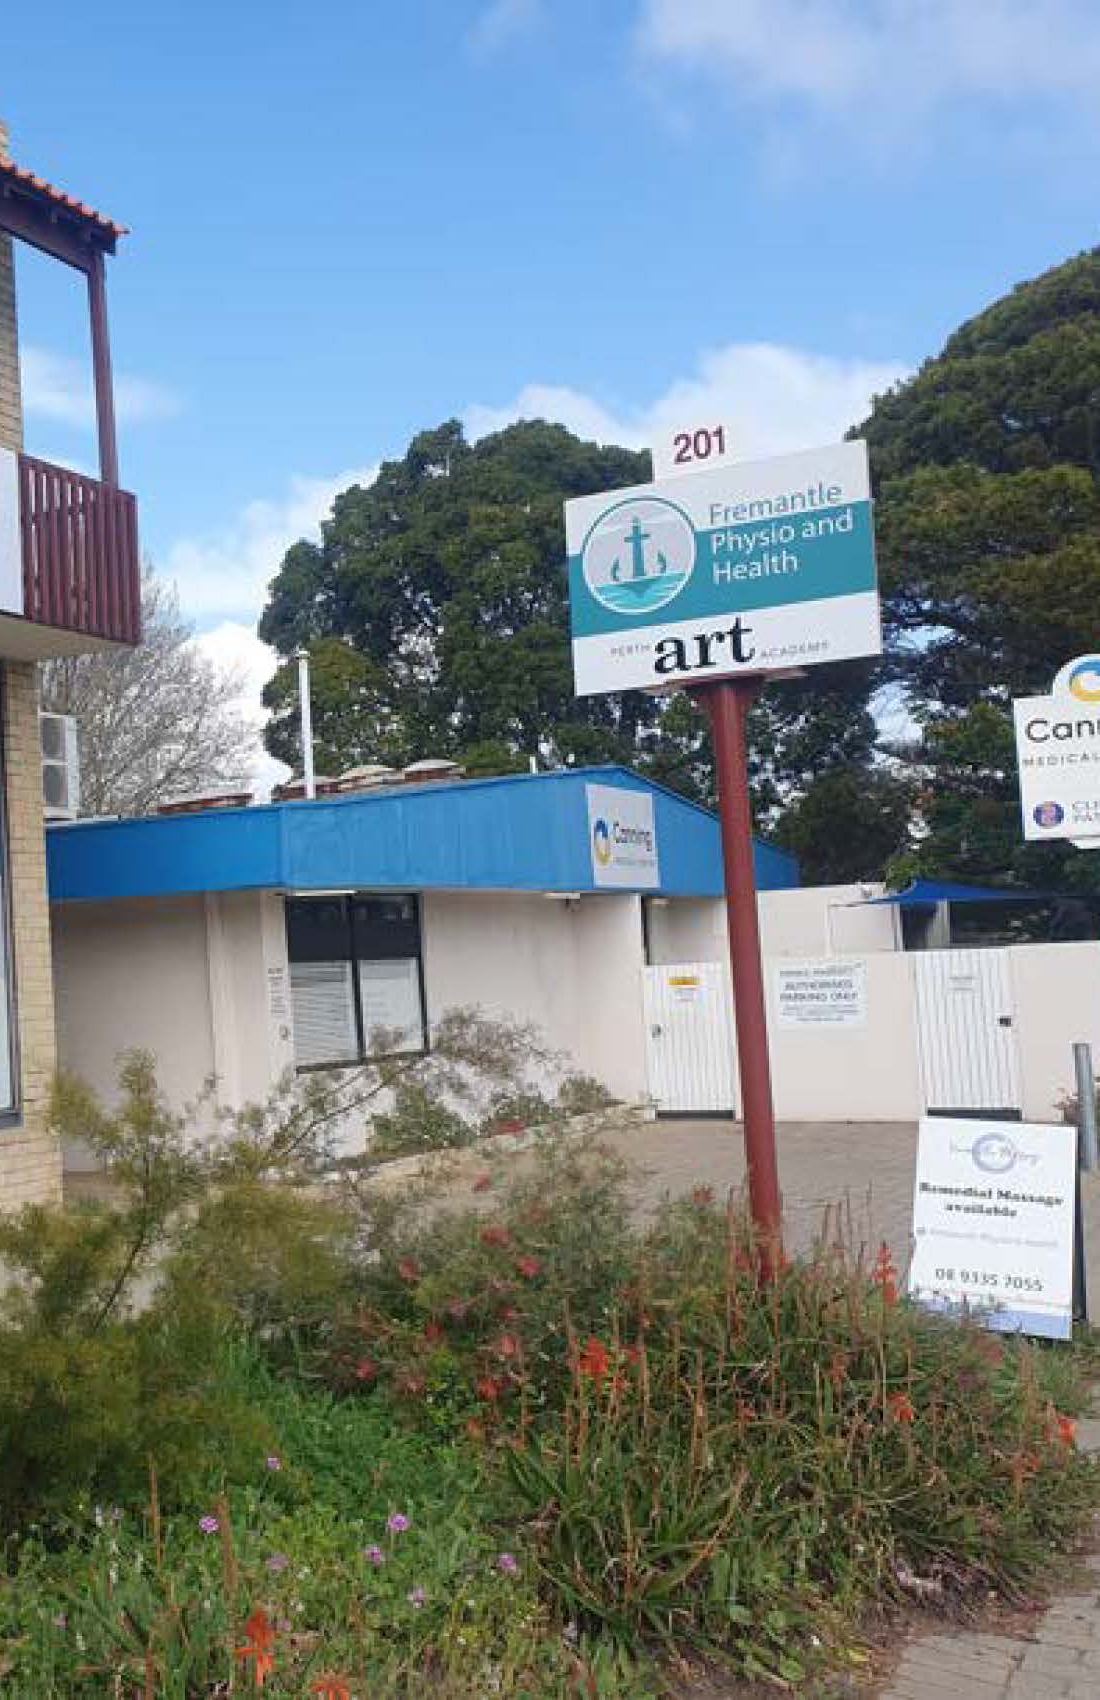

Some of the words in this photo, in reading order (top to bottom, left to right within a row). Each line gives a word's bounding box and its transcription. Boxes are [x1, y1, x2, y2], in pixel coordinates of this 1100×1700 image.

[674, 425, 726, 464] 201
[710, 480, 843, 525] Fremantle
[712, 522, 795, 554] Physio
[801, 507, 853, 538] and
[713, 549, 798, 584] Health
[654, 616, 756, 673] art
[919, 1182, 992, 1200] Remedial
[996, 1190, 1064, 1208] Massage
[946, 1204, 1017, 1217] available
